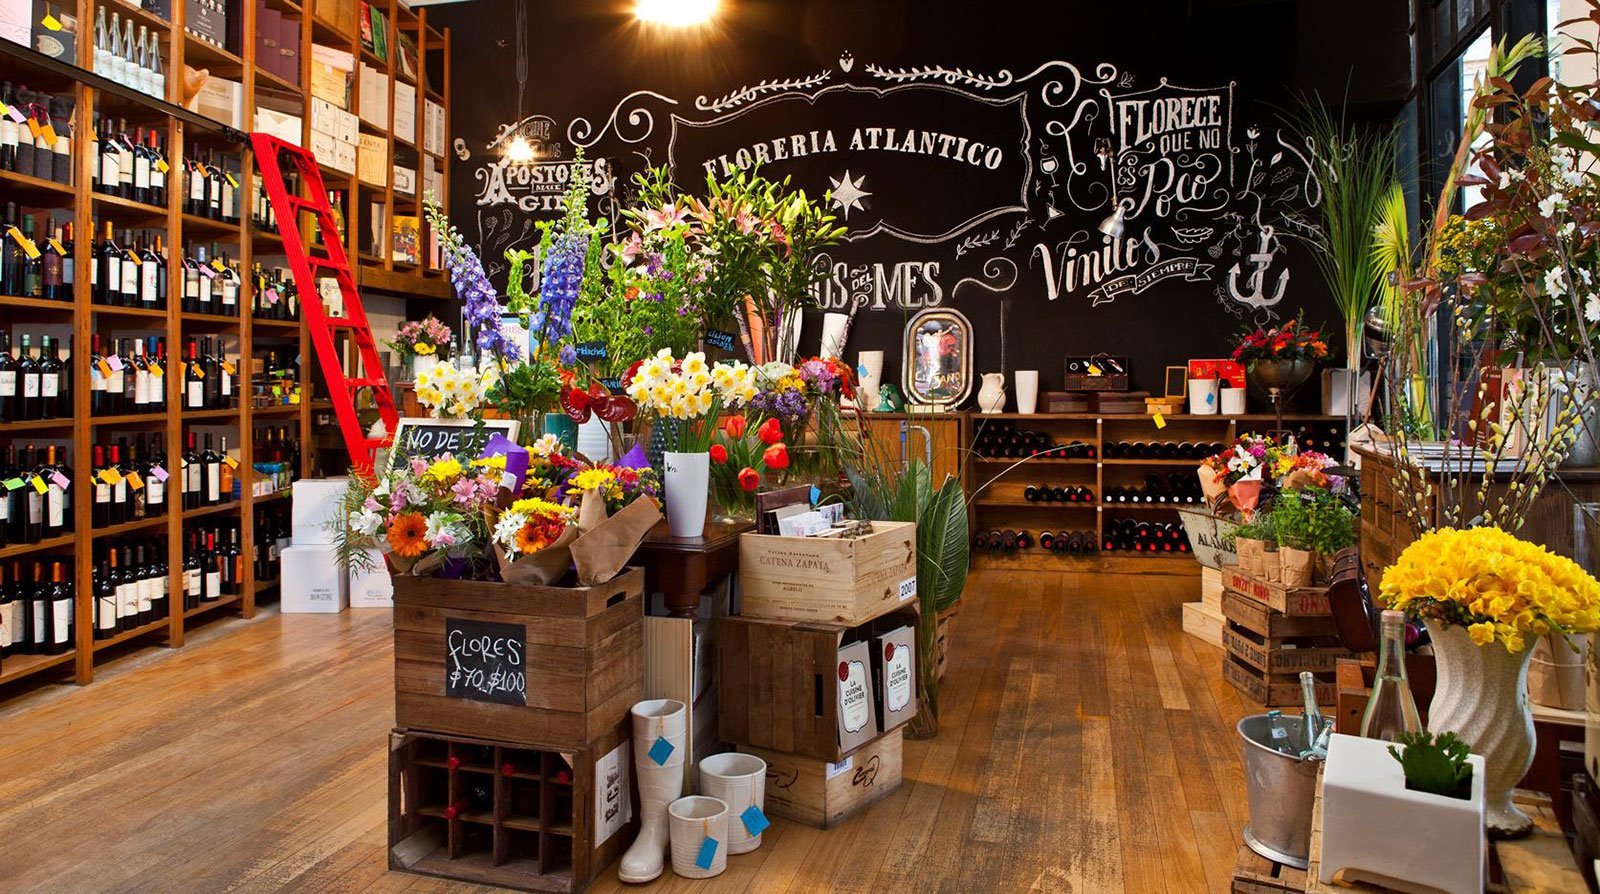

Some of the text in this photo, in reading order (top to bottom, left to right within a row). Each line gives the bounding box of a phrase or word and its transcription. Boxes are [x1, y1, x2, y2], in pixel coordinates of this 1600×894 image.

[1116, 95, 1221, 151] FLORECE
[702, 127, 1003, 182] FLORERIA ATLANTICO
[1160, 129, 1219, 157] QUE NO
[1117, 166, 1136, 186] ES
[1120, 156, 1221, 220] Poco
[1029, 226, 1161, 300] Vinilos
[1138, 262, 1194, 288] SIEMPRE
[852, 272, 874, 291] DEL
[870, 262, 943, 311] MES
[409, 429, 433, 450] NO
[760, 556, 829, 571] CATENA ZAPATA
[901, 580, 915, 597] 2007
[448, 630, 521, 670] FLORES
[845, 684, 862, 697] CUISINE
